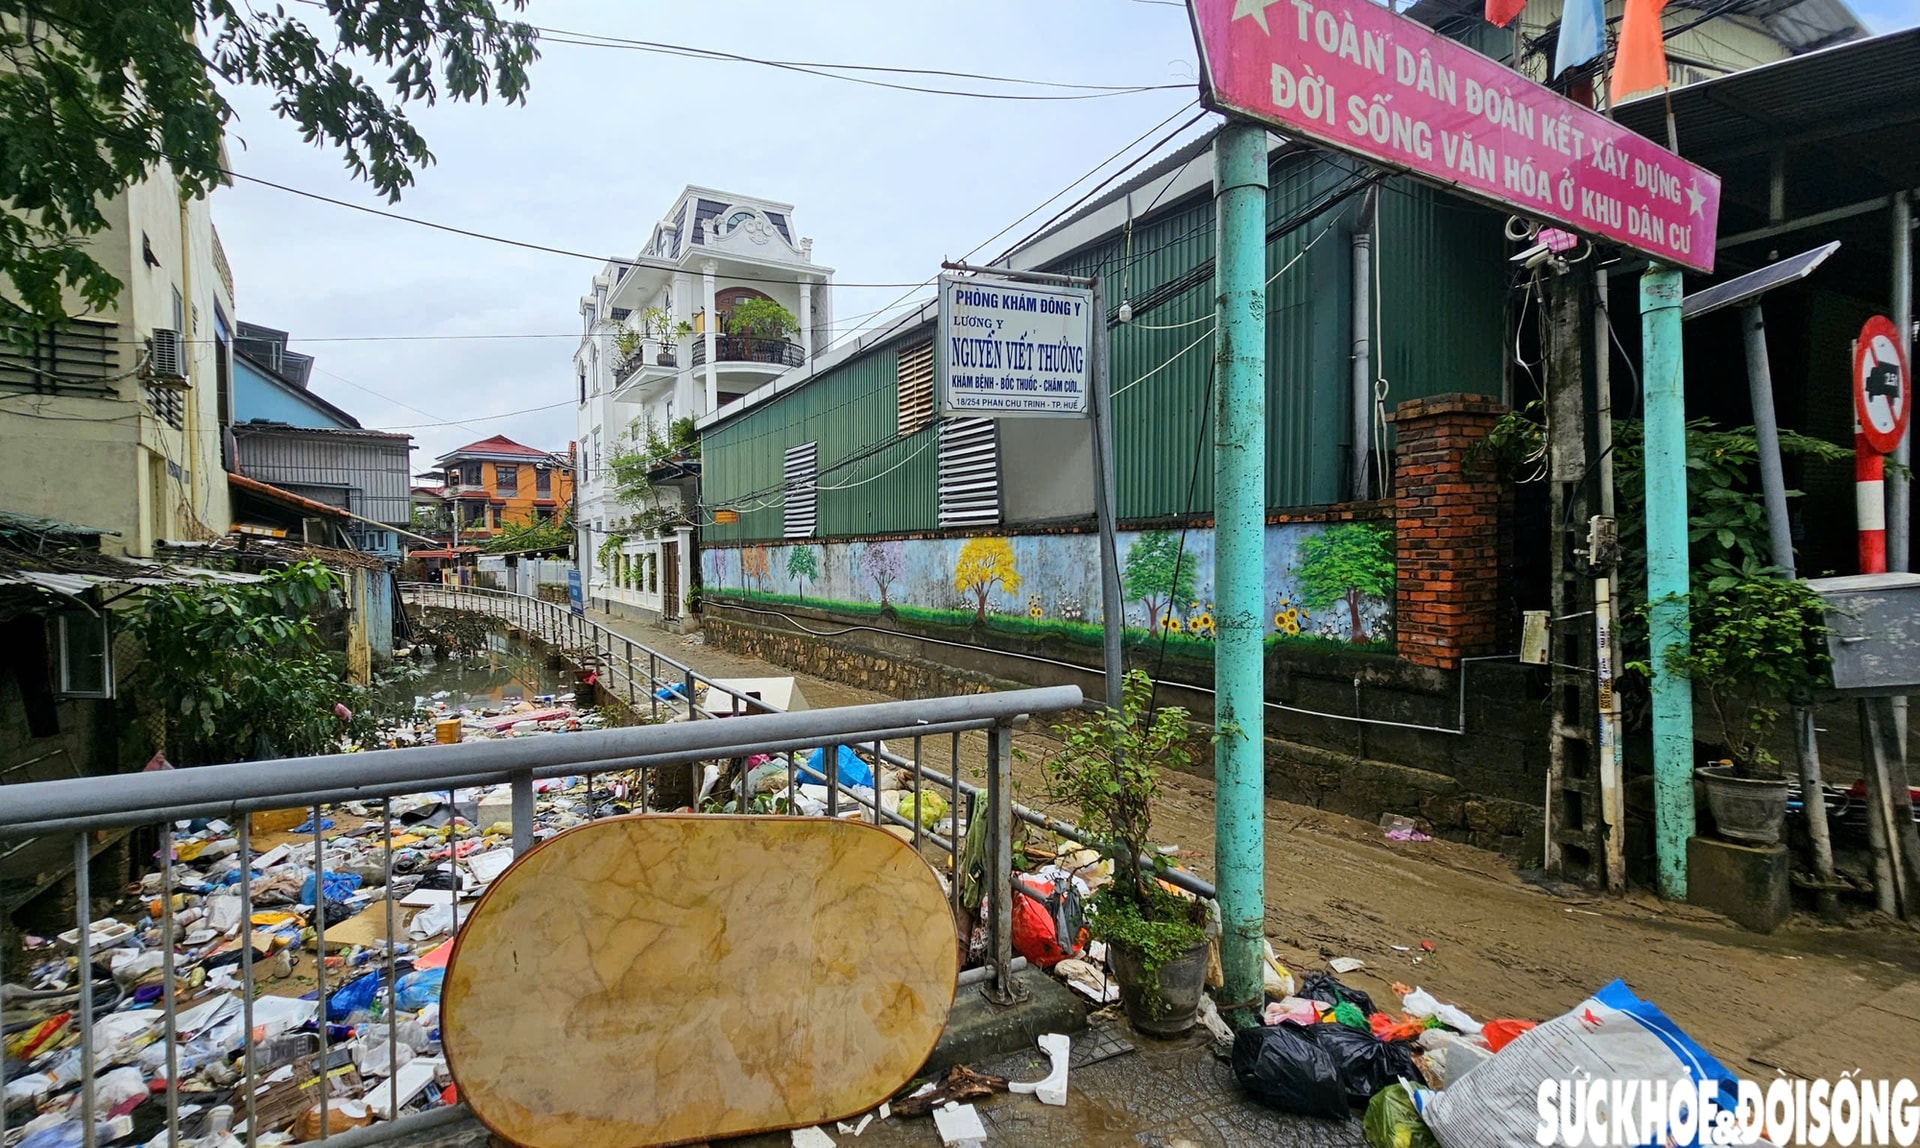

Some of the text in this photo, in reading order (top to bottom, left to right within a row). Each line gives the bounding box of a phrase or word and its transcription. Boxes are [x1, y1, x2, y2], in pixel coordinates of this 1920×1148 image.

[1290, 0, 1682, 205] TOÀN DÂN ĐOÀN KẾT XÂY DỰNG
[1270, 62, 1335, 126] ĐỜI
[1347, 93, 1432, 161] SỐNG
[1440, 130, 1495, 183] VĂN
[1504, 155, 1553, 204] HÓA
[1558, 167, 1575, 211] Ở
[1581, 186, 1622, 229] KHU
[1628, 203, 1664, 245] DÂN
[1669, 222, 1692, 254] CƯ
[955, 288, 1081, 316] PHÒNG KHÁM ĐÔNG Y
[954, 315, 1004, 329] LƯƠNG Y
[1005, 331, 1034, 371] VIẾT
[952, 372, 974, 388] KHÁM
[975, 373, 994, 392] BỆNH
[1000, 373, 1015, 390] BỐC
[1016, 374, 1038, 391] THUỐC
[956, 398, 980, 406] 18/254
[982, 398, 1004, 407] PHAN
